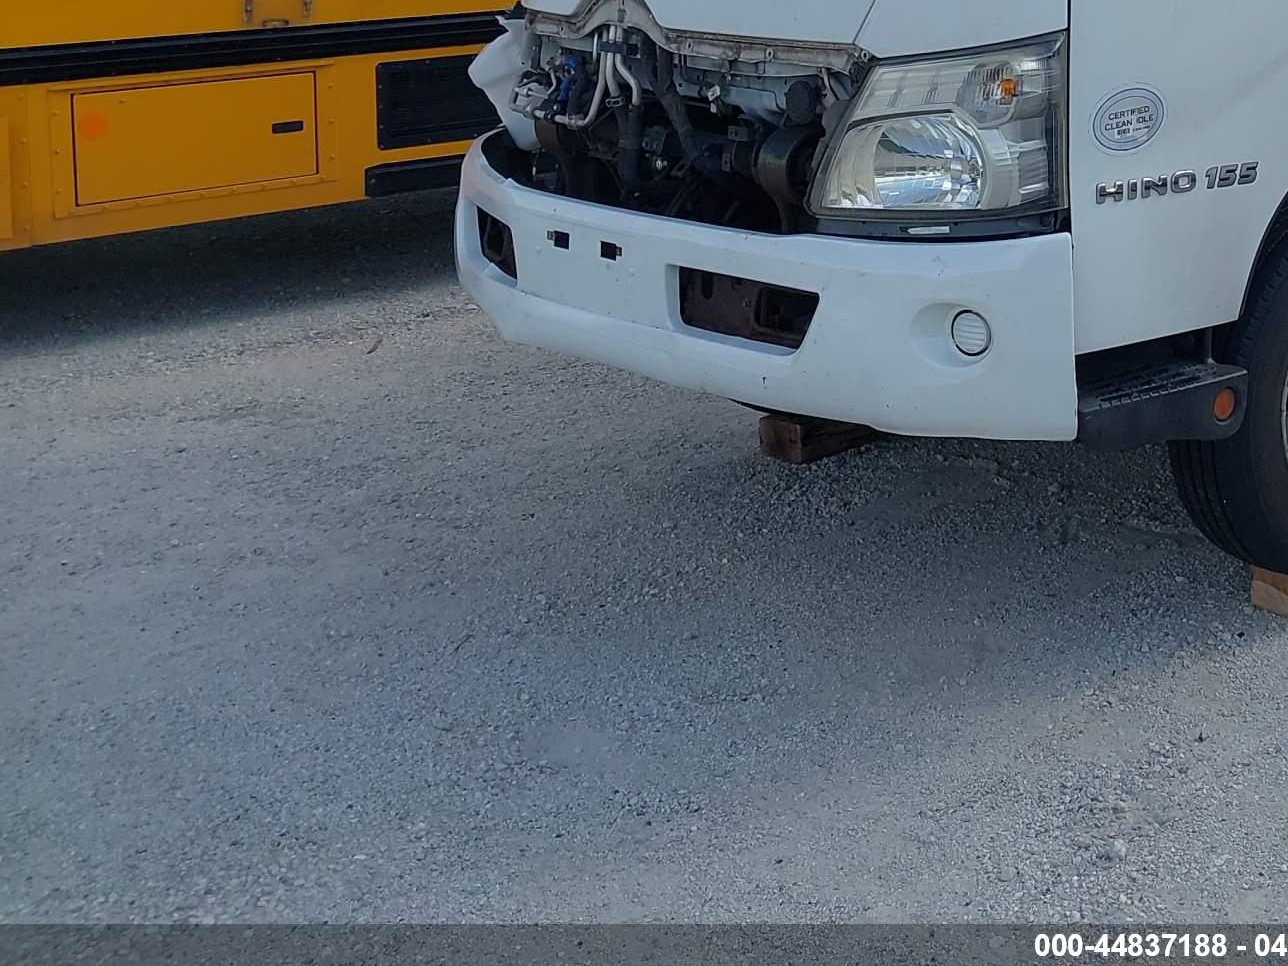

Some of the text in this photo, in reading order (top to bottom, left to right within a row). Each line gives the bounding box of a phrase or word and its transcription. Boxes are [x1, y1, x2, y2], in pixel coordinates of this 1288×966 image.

[1108, 105, 1150, 121] CERTIFIED
[1104, 119, 1133, 131] CLEAN
[1136, 114, 1154, 124] IDLE
[1096, 161, 1259, 204] HINO 155
